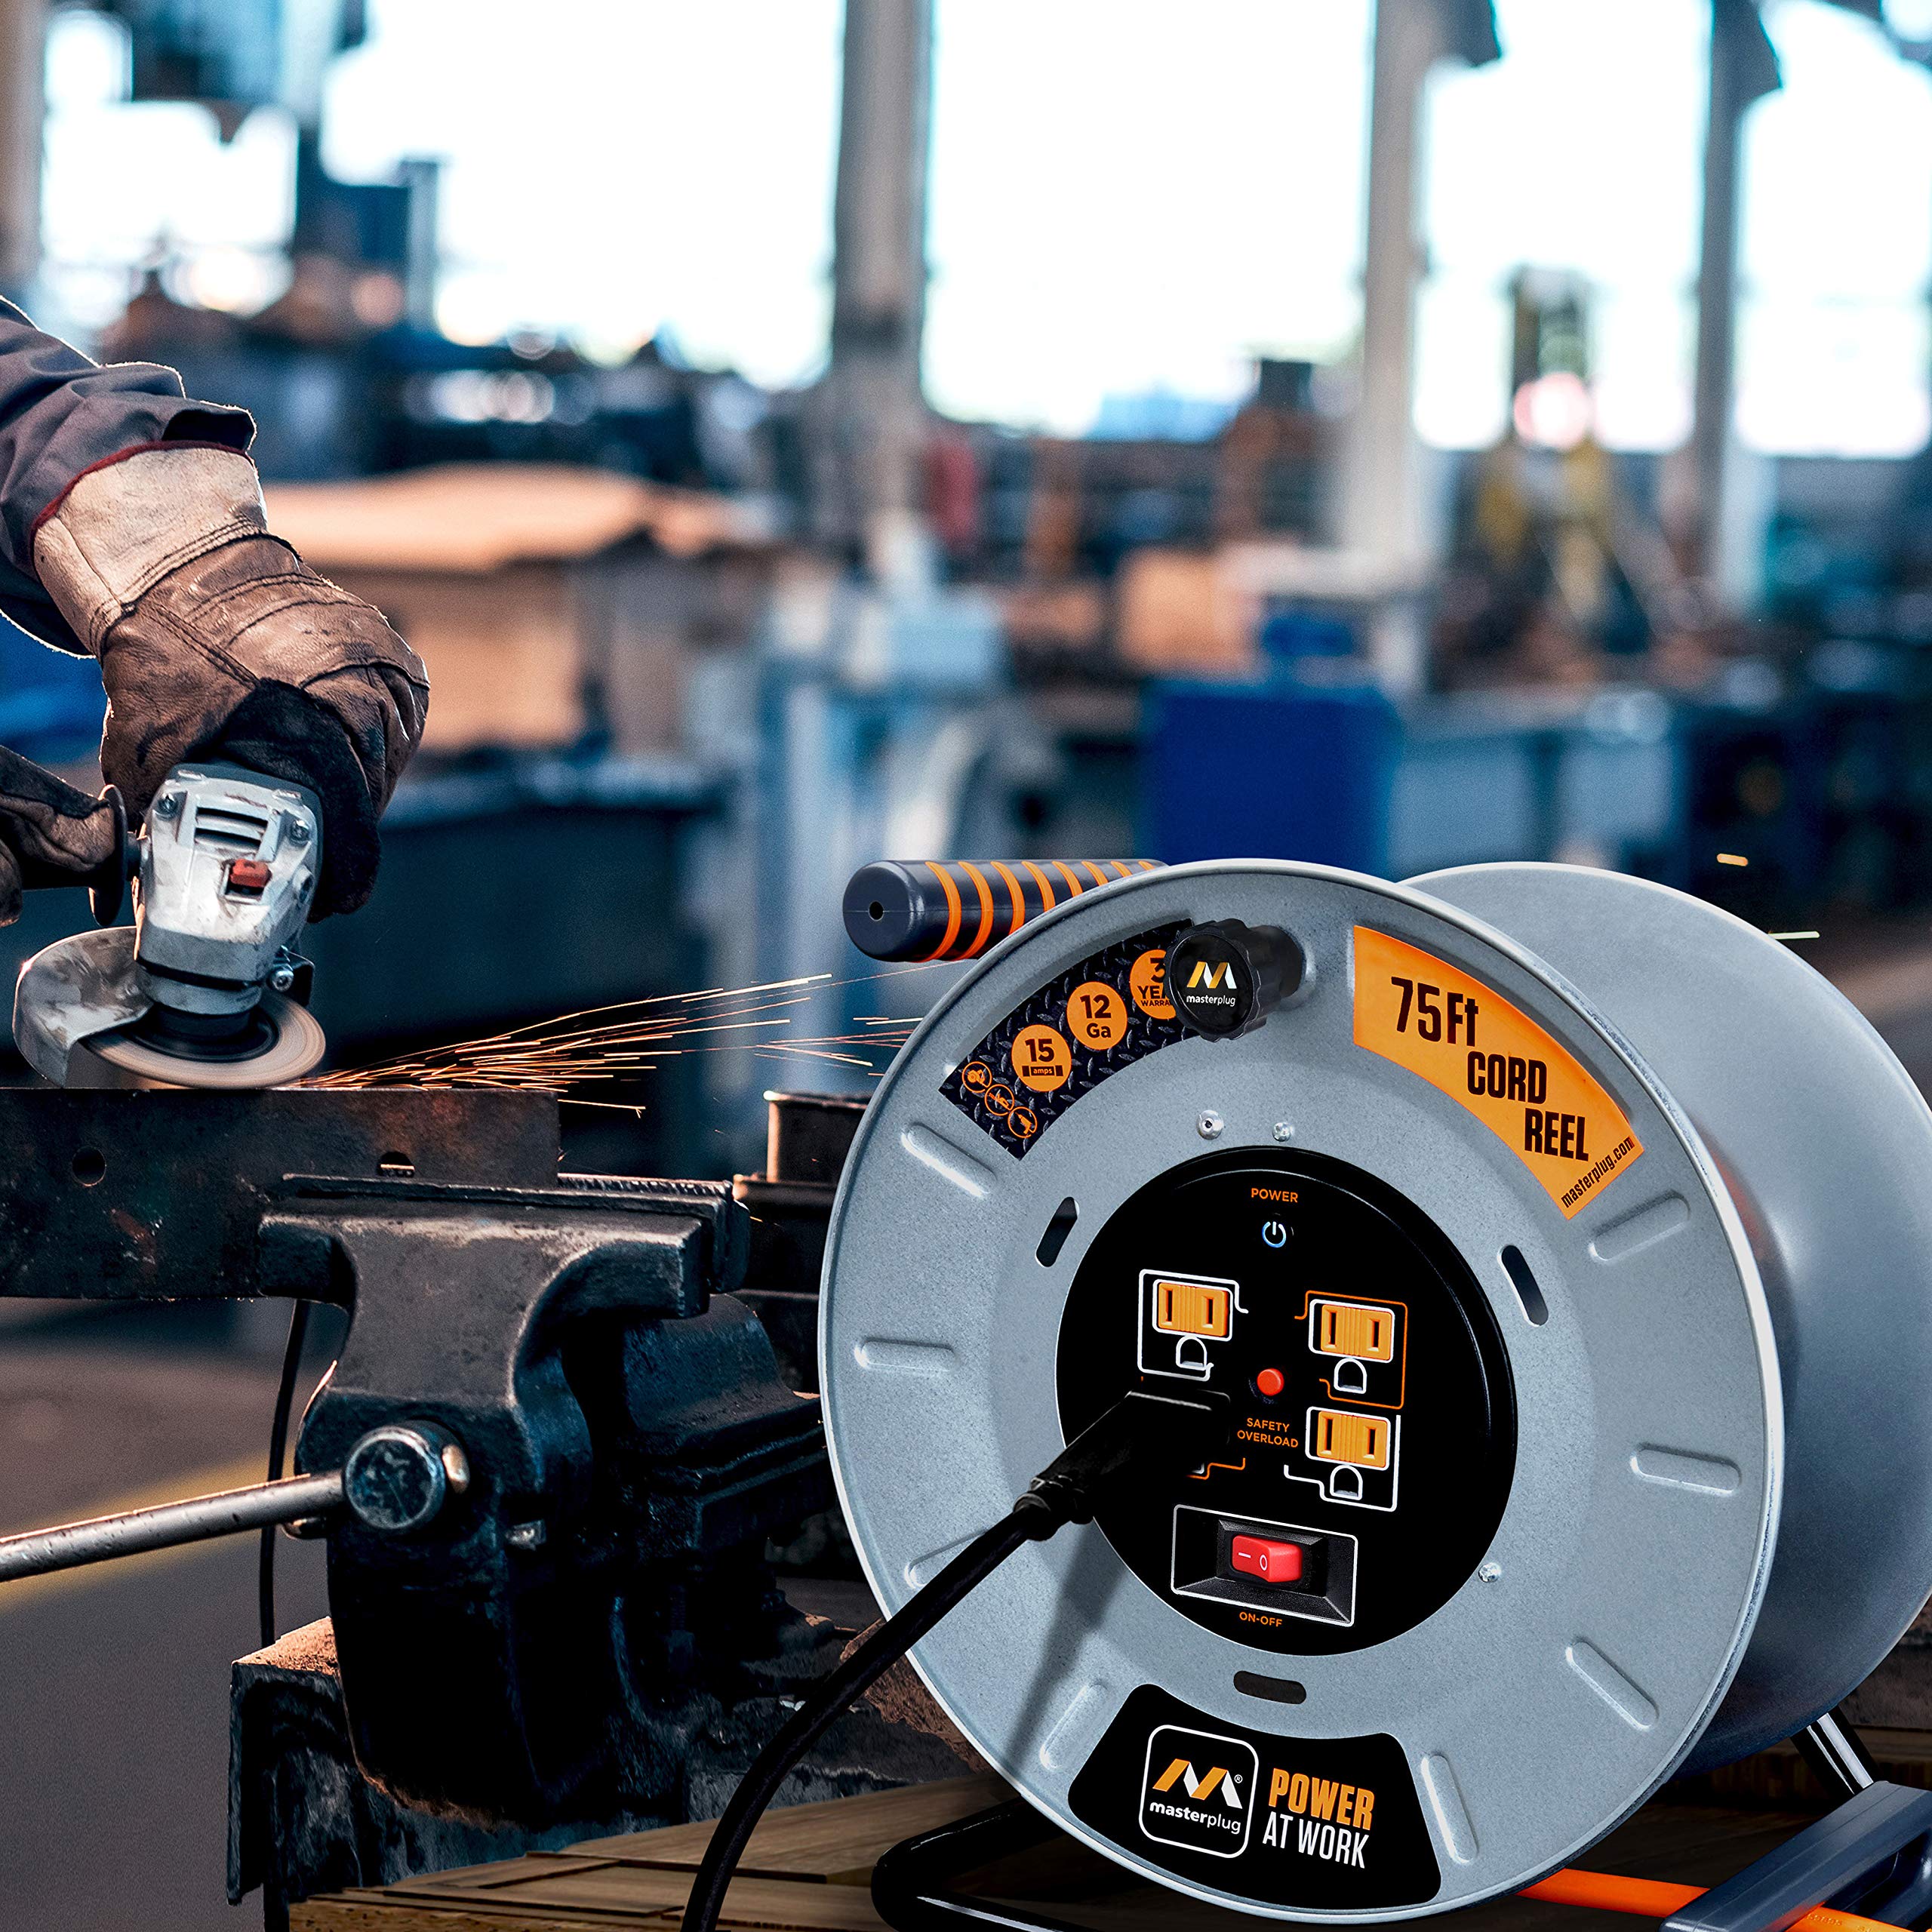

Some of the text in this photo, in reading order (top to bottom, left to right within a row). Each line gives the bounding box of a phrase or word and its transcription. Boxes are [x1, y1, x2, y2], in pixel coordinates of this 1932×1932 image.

[1137, 986, 1166, 999] YE
[1186, 995, 1236, 1008] masterplug
[1080, 994, 1112, 1019] 12
[1391, 976, 1479, 1047] 75Ft
[1086, 1023, 1112, 1038] Ga
[1024, 1038, 1055, 1063] 15
[1467, 1051, 1547, 1104] CORD
[1524, 1107, 1589, 1162] REEL
[1561, 1136, 1635, 1208] masterplug.com
[1251, 1187, 1299, 1203] POWER
[1246, 1417, 1290, 1432] SAFETY
[1237, 1430, 1299, 1448] OVERLOAD
[1239, 1611, 1283, 1627] ON-OFF
[1268, 1767, 1376, 1831] POWER
[1149, 1801, 1241, 1835] masterplug
[1263, 1811, 1370, 1869] AT WORK
